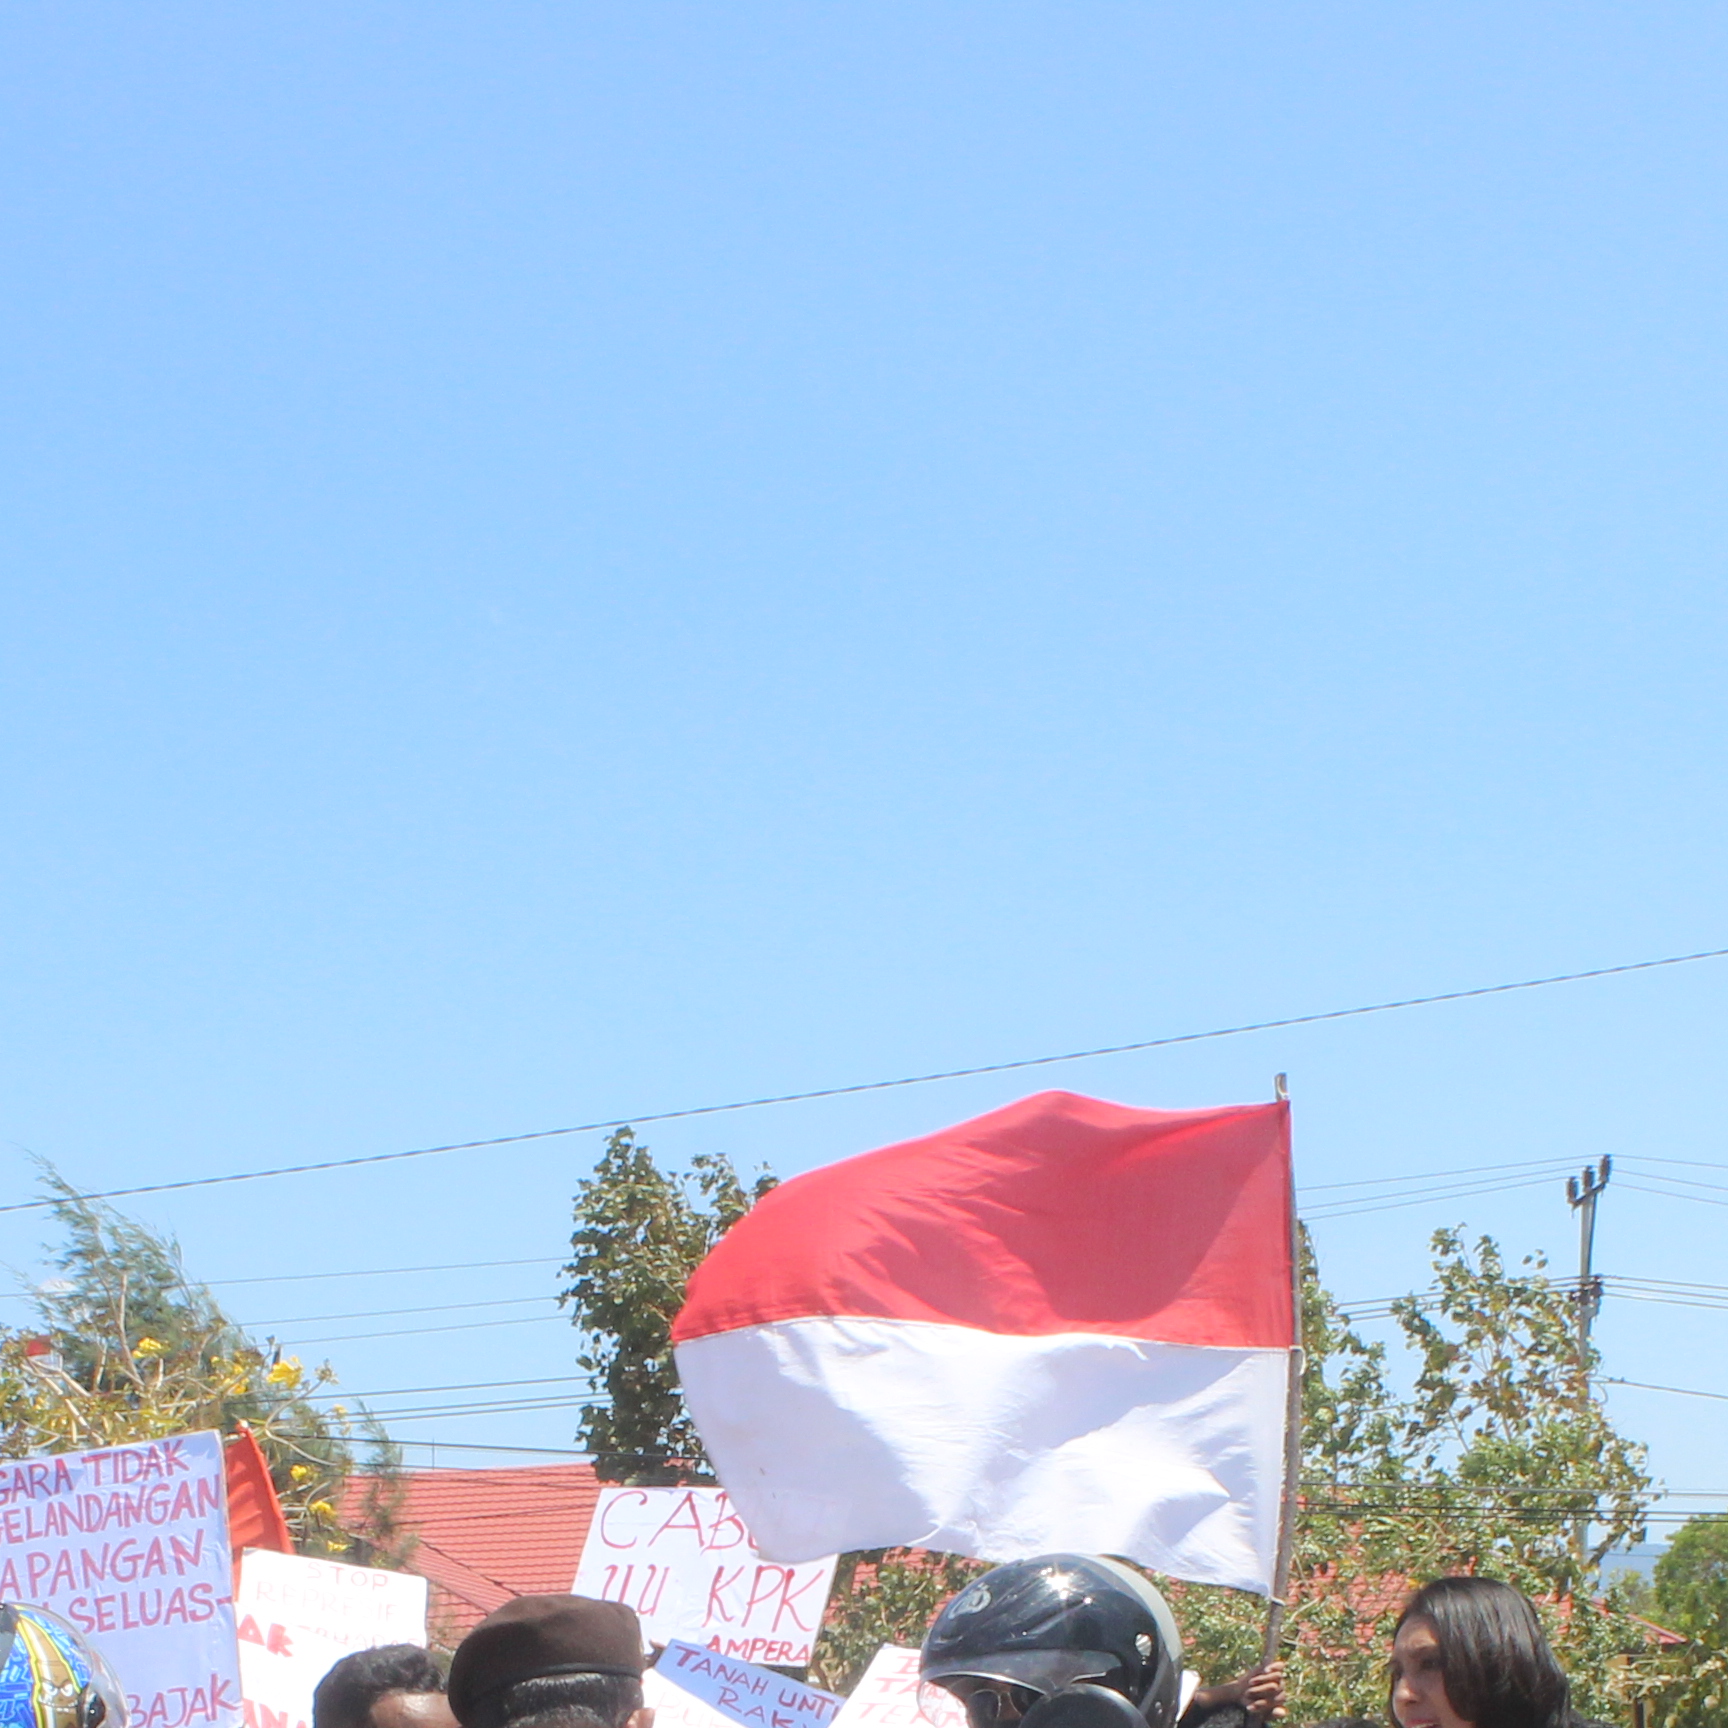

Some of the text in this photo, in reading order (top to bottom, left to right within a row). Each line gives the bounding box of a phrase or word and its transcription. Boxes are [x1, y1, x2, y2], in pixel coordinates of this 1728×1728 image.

[81, 1439, 190, 1487] TIDAK
[307, 1561, 389, 1591] STOP
[256, 1581, 398, 1622] REPRESIF
[701, 1565, 824, 1634] KPK
[674, 1645, 769, 1696] TANAH
[706, 1634, 812, 1663] AMPERA
